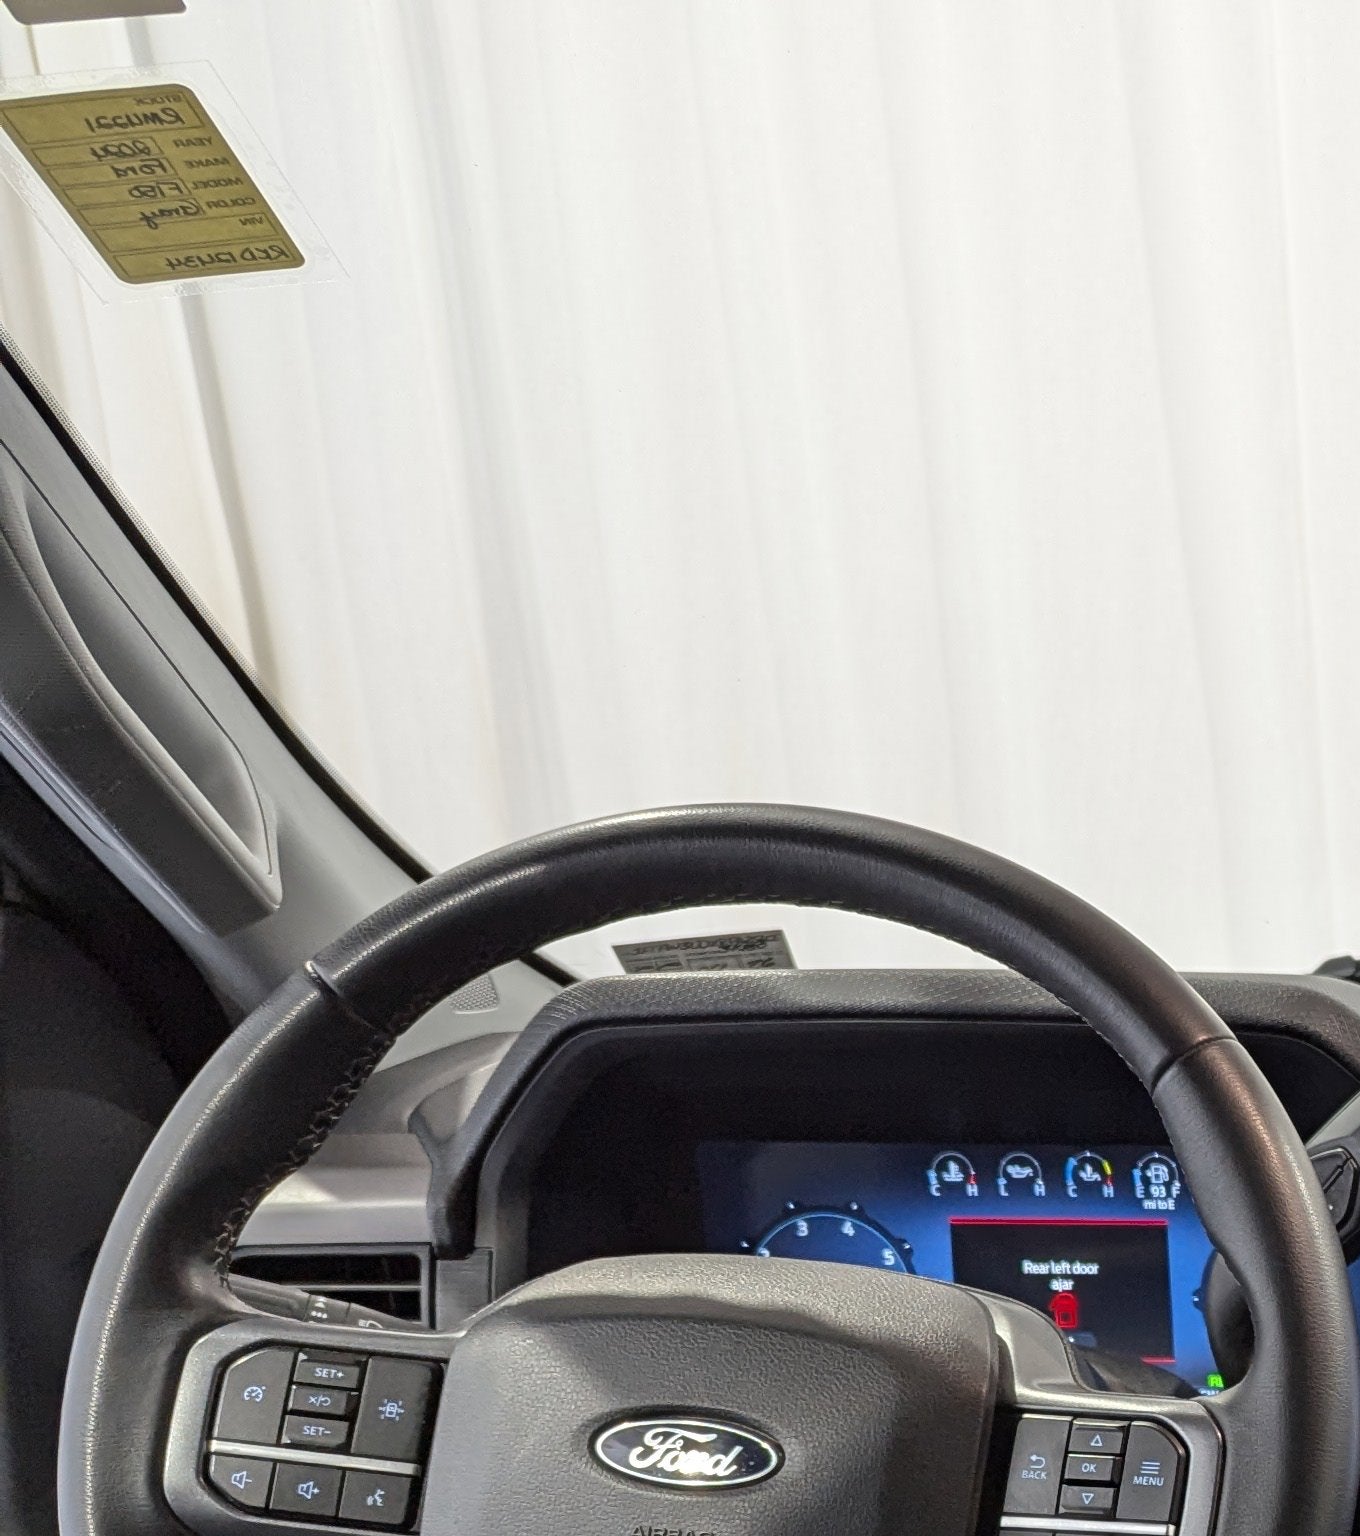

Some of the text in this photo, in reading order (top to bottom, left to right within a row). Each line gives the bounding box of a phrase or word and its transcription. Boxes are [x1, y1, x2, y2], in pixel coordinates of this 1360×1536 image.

[931, 1184, 941, 1197] C
[967, 1185, 978, 1197] H
[999, 1184, 1009, 1197] L
[1034, 1184, 1046, 1197] H
[1067, 1185, 1078, 1198] C
[1103, 1185, 1114, 1198] H
[1136, 1186, 1145, 1199] E
[1151, 1186, 1167, 1199] 93
[1171, 1186, 1181, 1199] F
[1143, 1200, 1157, 1209] mi
[796, 1220, 808, 1236] 3
[841, 1220, 855, 1236] 4
[882, 1248, 895, 1266] 5
[1022, 1261, 1099, 1275] Rear left door
[1051, 1280, 1074, 1292] ajar
[629, 1427, 744, 1477] Ford
[1081, 1463, 1097, 1473] OK
[1022, 1470, 1047, 1480] BACK
[1133, 1476, 1164, 1487] MENU
